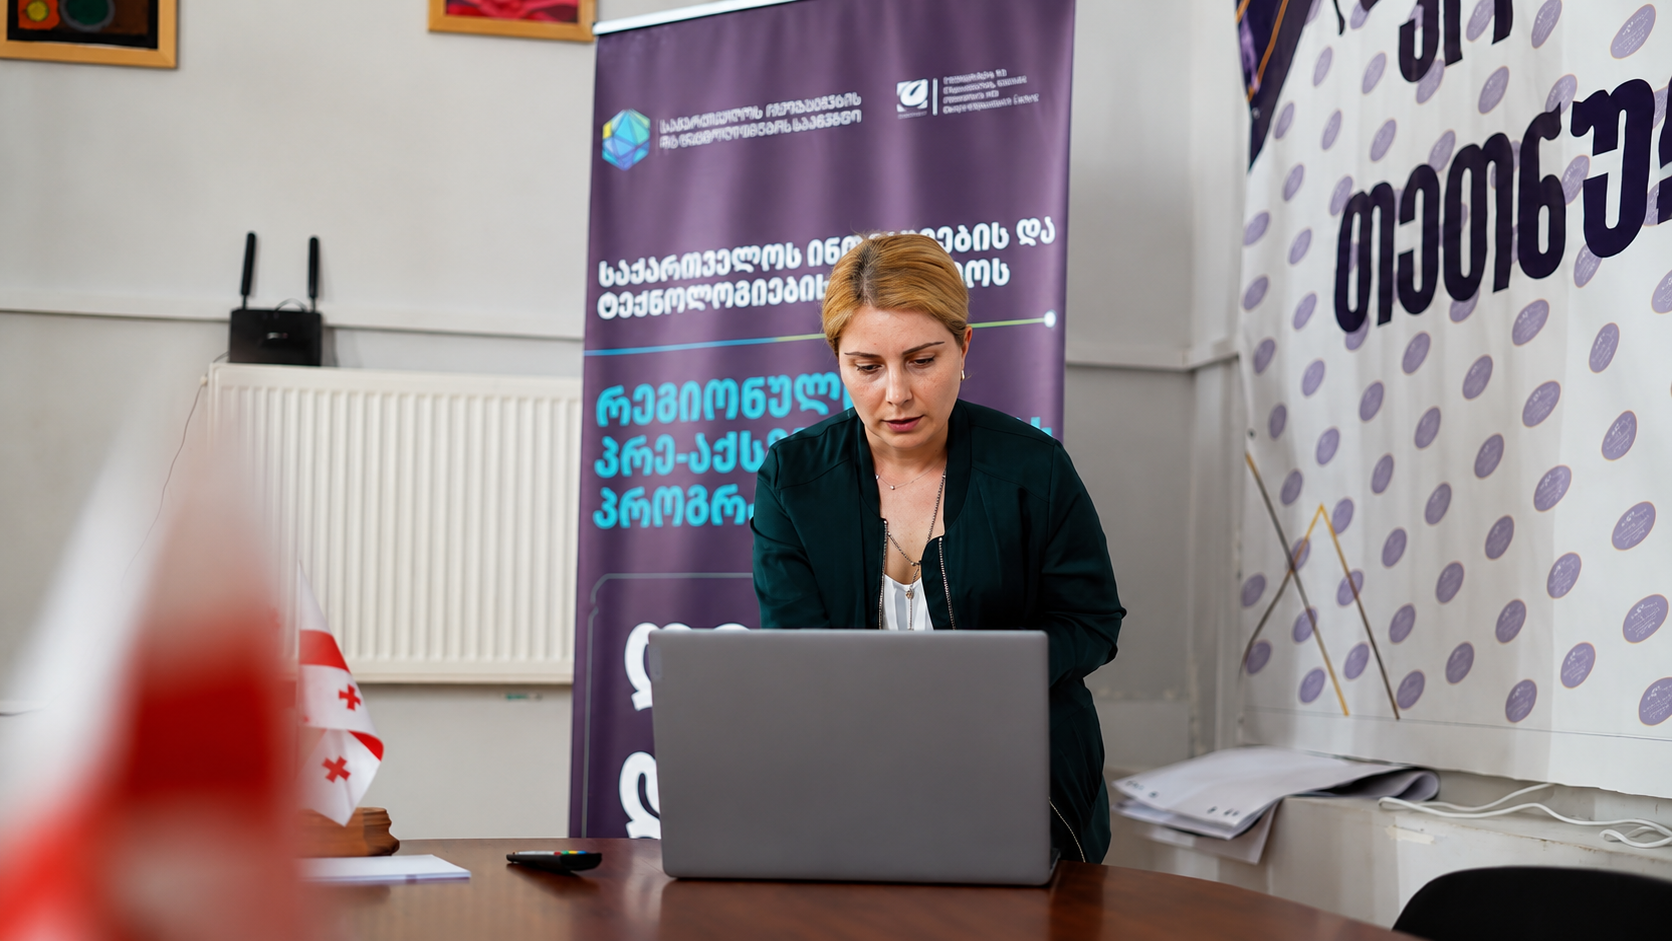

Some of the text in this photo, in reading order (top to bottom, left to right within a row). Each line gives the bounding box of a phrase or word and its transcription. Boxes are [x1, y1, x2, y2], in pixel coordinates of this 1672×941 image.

[598, 242, 802, 288] საქართველოს
[1016, 216, 1056, 246] და
[592, 484, 754, 530] პროგრ
